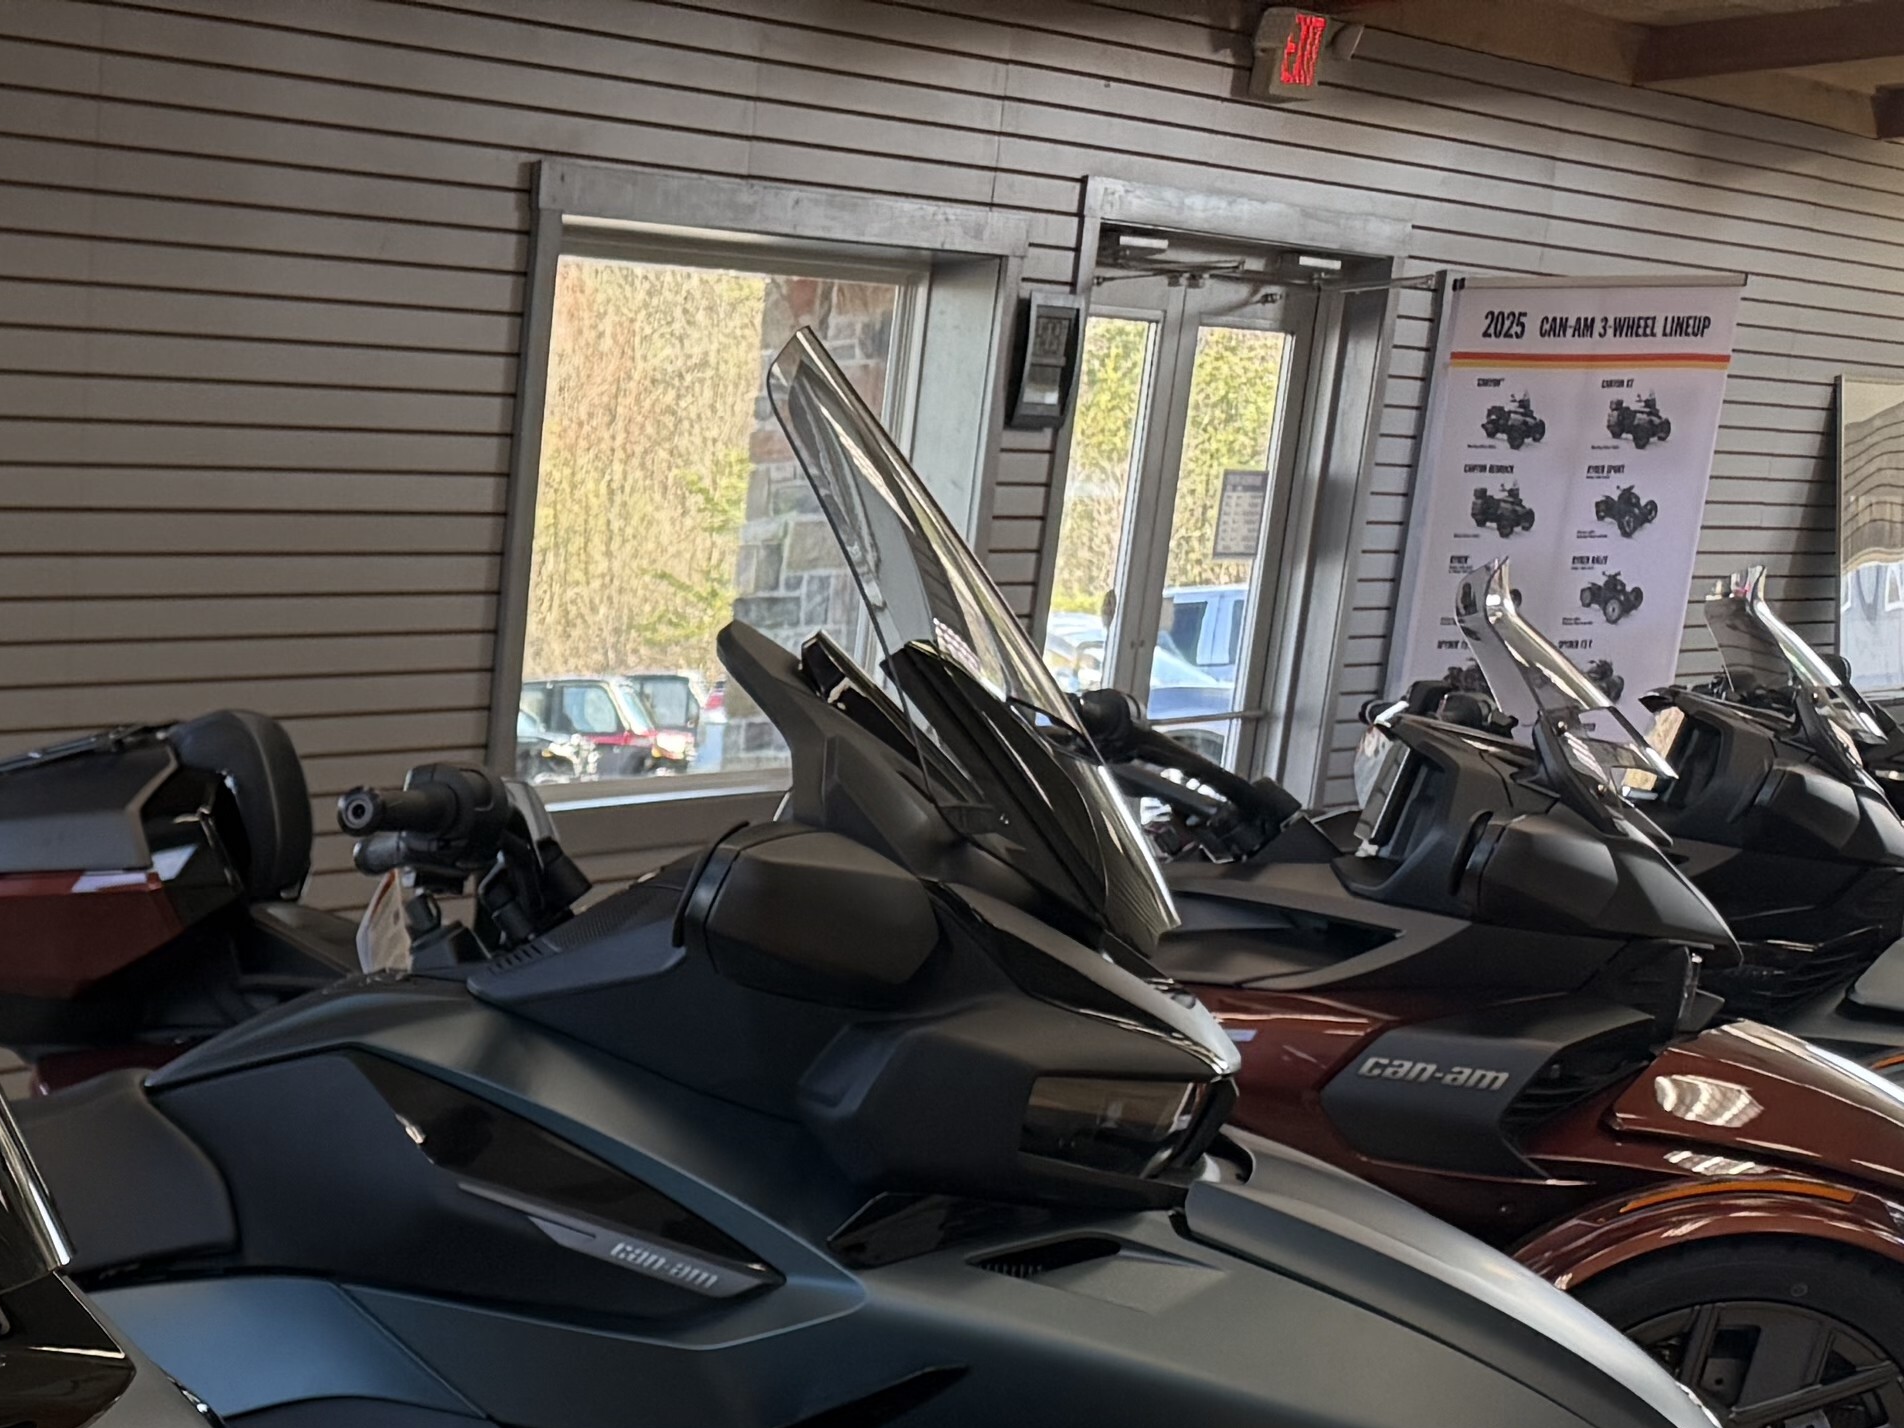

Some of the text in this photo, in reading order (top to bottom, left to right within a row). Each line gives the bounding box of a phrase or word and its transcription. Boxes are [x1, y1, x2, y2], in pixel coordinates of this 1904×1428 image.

[1482, 310, 1712, 339] 2025 CAN-AM 3-WHEEL LINEUP
[1357, 1056, 1510, 1091] can-am
[609, 1241, 719, 1289] can-am
